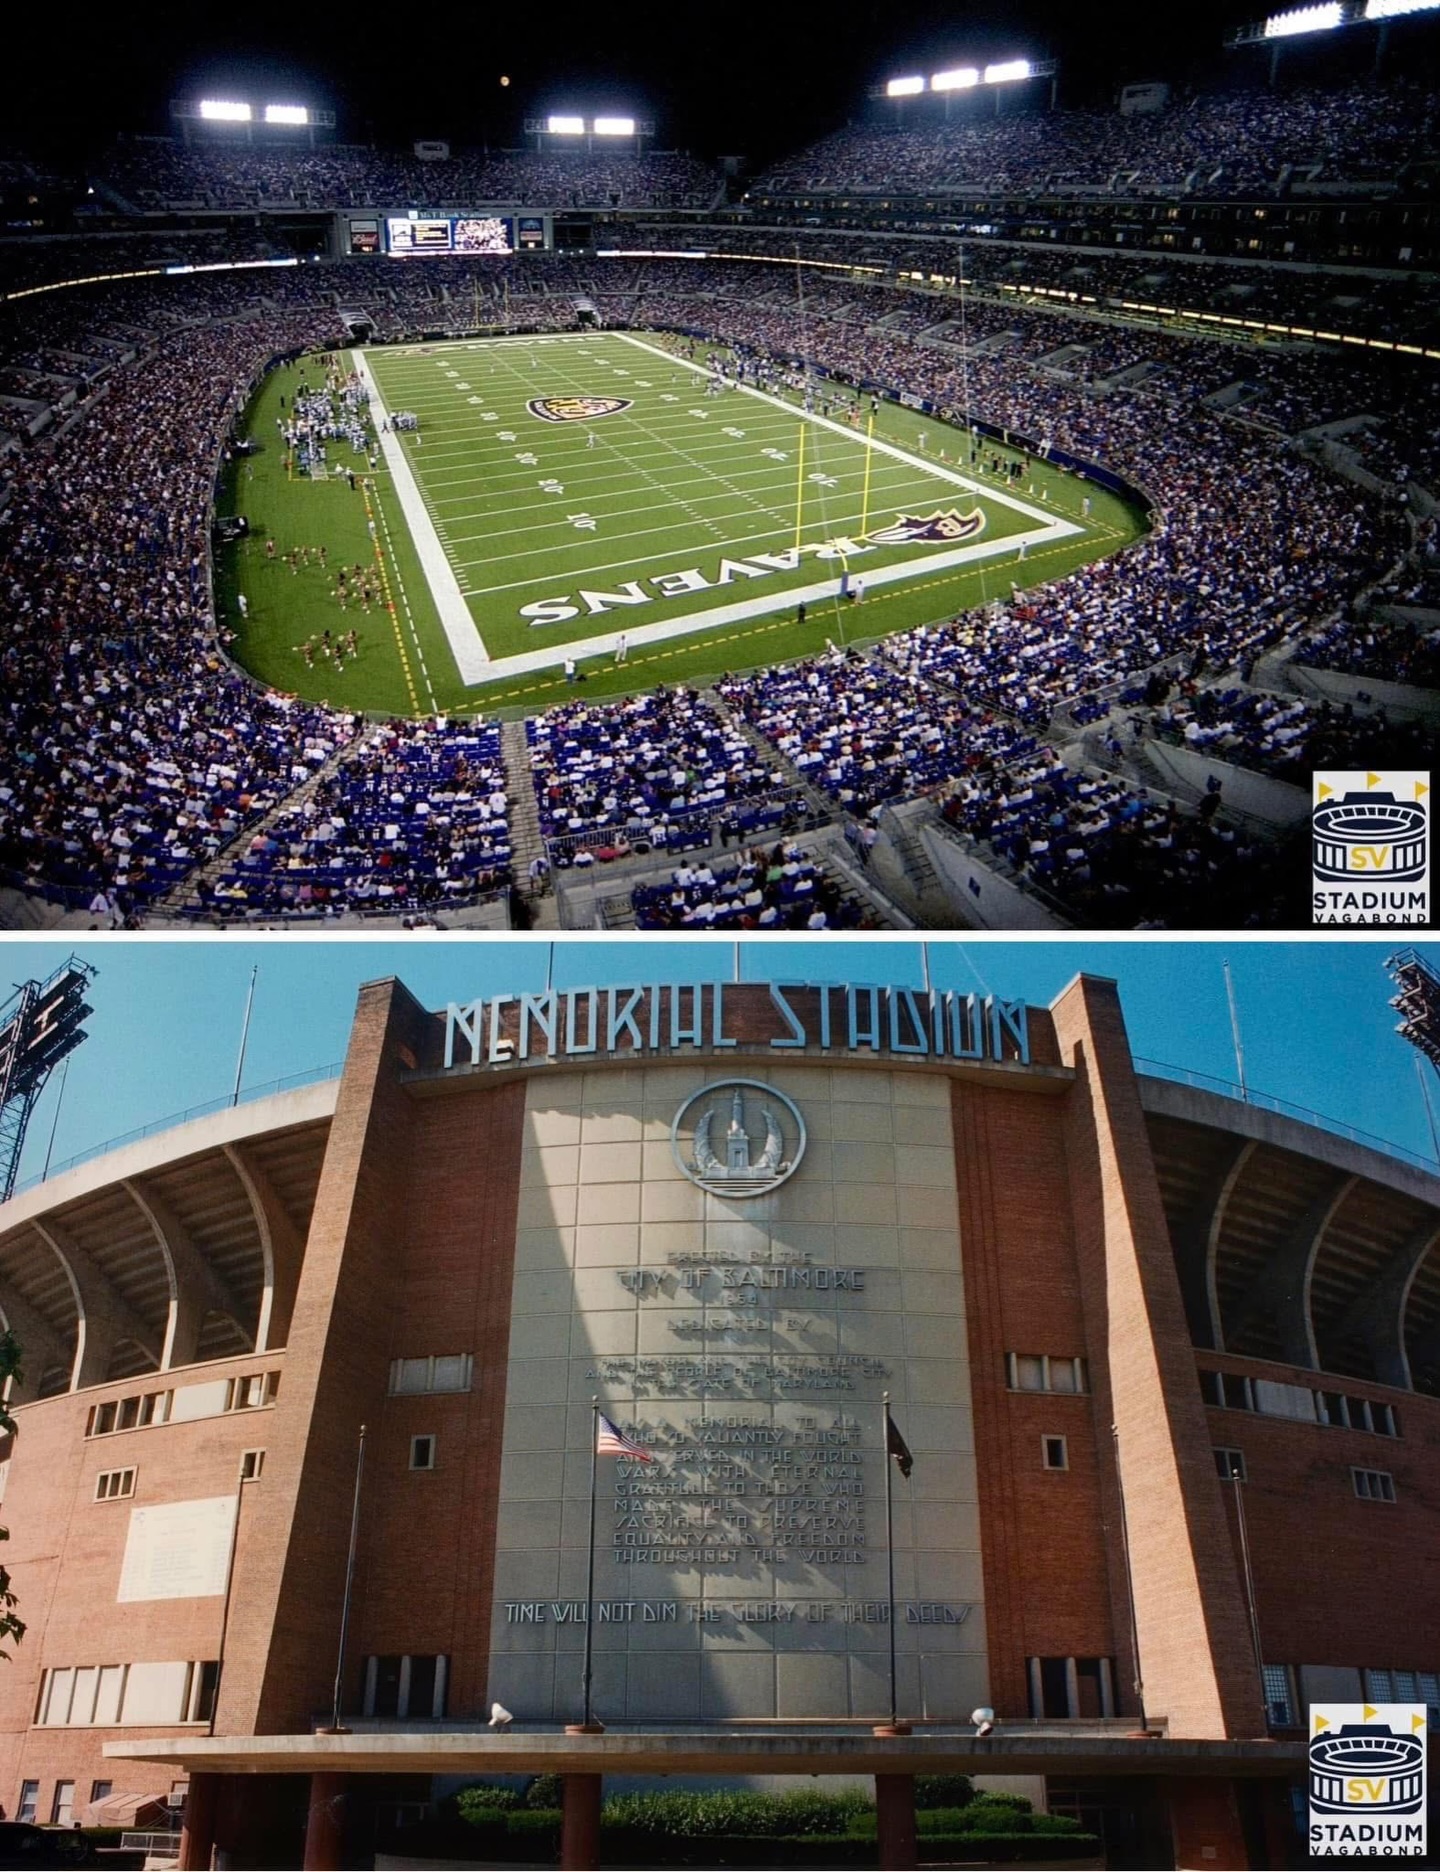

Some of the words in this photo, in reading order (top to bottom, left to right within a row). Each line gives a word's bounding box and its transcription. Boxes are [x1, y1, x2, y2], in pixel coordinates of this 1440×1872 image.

[519, 537, 877, 627] RAVENS
[443, 981, 738, 1069] MEMORIAL
[770, 979, 1031, 1066] STADIUM
[680, 1267, 711, 1289] OF
[722, 1266, 865, 1291] BALTIMORE
[795, 1417, 816, 1430] TO
[793, 1432, 863, 1445] FOUGHT
[739, 1450, 754, 1462] IN
[762, 1450, 792, 1463] THE
[801, 1450, 863, 1464] WORLD
[697, 1465, 745, 1478] WITH
[771, 1465, 864, 1480] ETERNAL
[615, 1482, 715, 1496] GRATITUDE
[724, 1482, 745, 1496] TO
[755, 1482, 814, 1496] THOSE
[822, 1483, 863, 1496] WHO
[614, 1499, 673, 1512] MADE
[700, 1499, 733, 1511] THE
[760, 1499, 865, 1513] SUPREME
[616, 1515, 714, 1529] SACRIFICE
[726, 1515, 747, 1529] TO
[760, 1516, 865, 1530] PRESERVE
[613, 1533, 708, 1547] EQUALITY
[771, 1533, 865, 1546] FREEDOM
[614, 1549, 740, 1563] THROUGHOUT
[752, 1549, 785, 1563] THE
[799, 1550, 865, 1563] WORLD
[504, 1603, 545, 1623] TIME
[552, 1603, 588, 1623] WILL
[599, 1603, 636, 1622] NOT
[643, 1603, 677, 1622] DIM
[685, 1603, 720, 1623] THE
[731, 1602, 797, 1623] GLORY
[808, 1603, 833, 1623] OF
[906, 1604, 972, 1624] DEEDS
